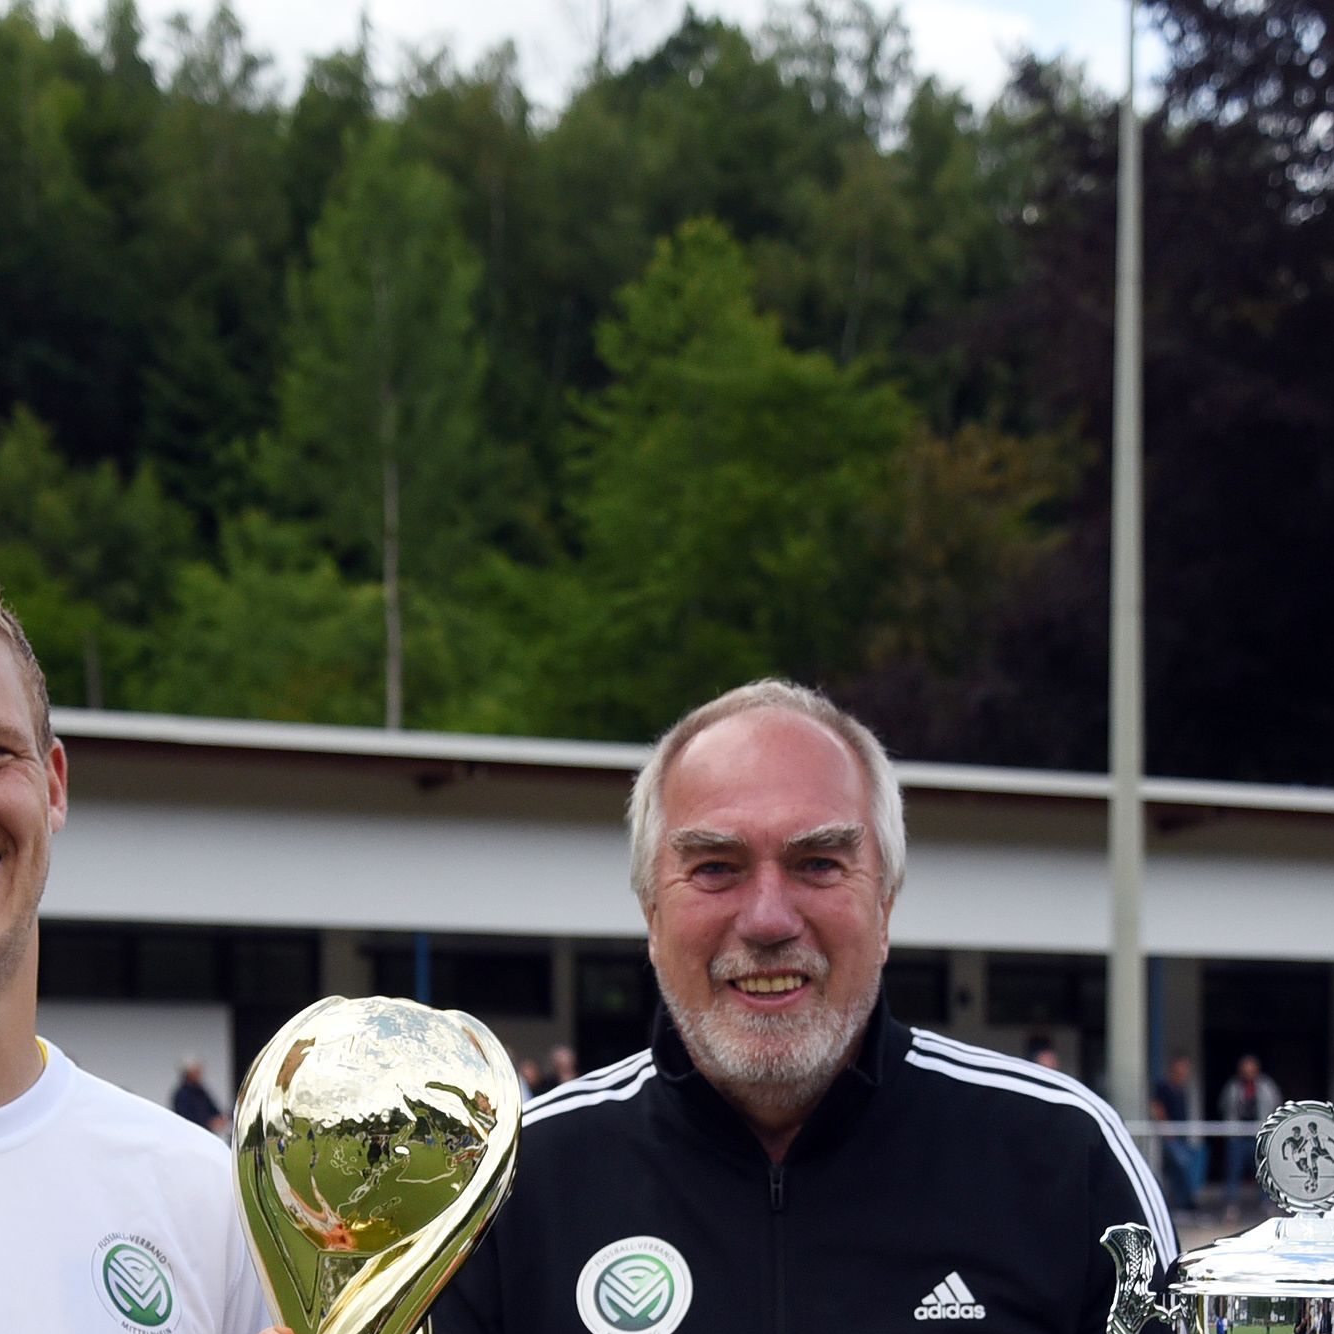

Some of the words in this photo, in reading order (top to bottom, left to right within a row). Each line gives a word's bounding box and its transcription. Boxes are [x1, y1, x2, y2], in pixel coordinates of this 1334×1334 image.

[98, 1232, 167, 1264] FUSSBALL-VERBAND
[594, 1242, 675, 1267] FUSSBALL-VERBAND
[913, 1301, 986, 1321] adidas
